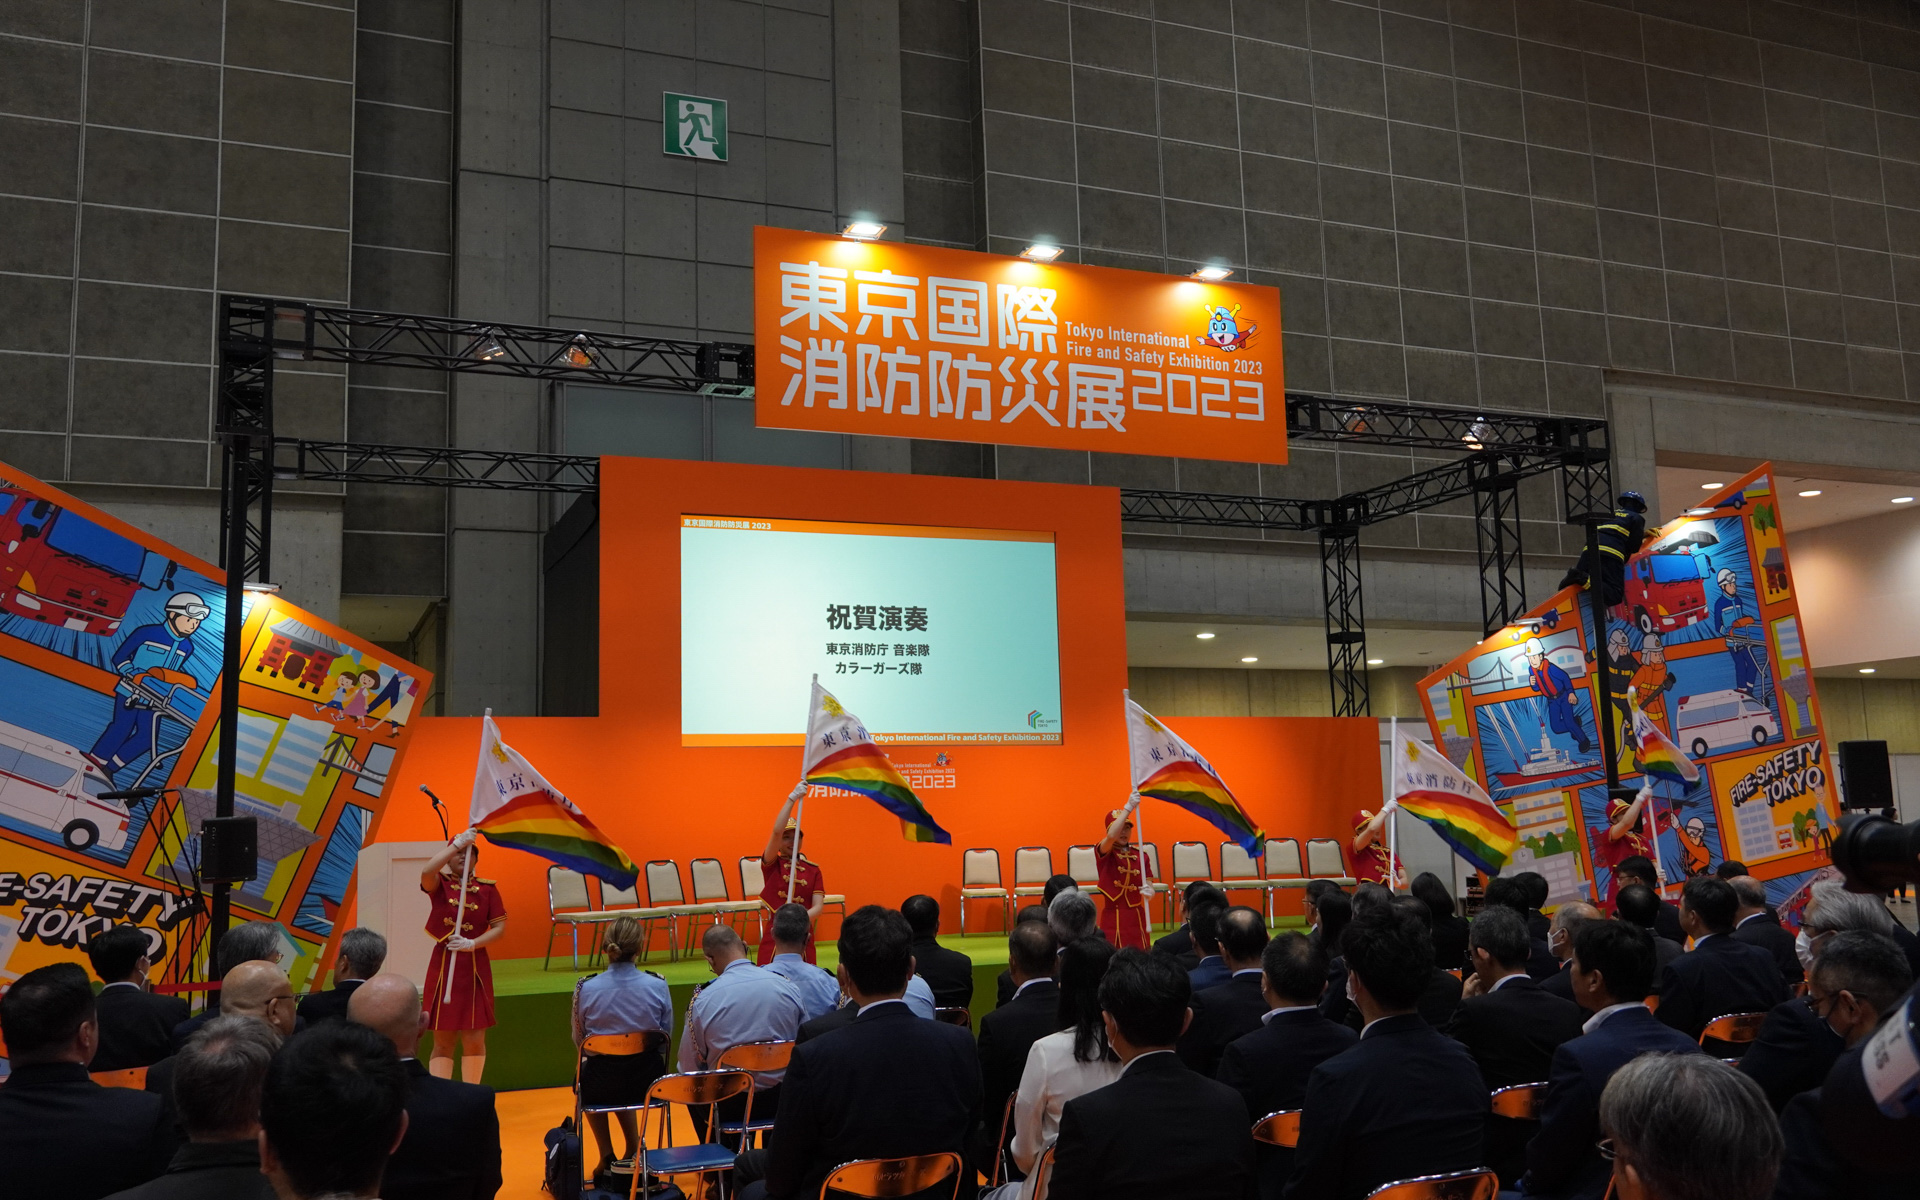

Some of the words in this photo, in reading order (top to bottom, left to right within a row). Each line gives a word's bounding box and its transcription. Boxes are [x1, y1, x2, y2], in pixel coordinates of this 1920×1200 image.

[780, 261, 1057, 353] 東京国際
[1065, 321, 1103, 342] Tokyo
[1108, 325, 1190, 349] International
[1067, 340, 1093, 357] Fire
[1097, 343, 1120, 361] and
[1125, 346, 1165, 368] Safety
[1169, 350, 1230, 372] Exhibition
[1234, 358, 1263, 375] 2023
[752, 522, 772, 530] 2023
[827, 603, 929, 632] 祝賀演奏
[826, 642, 889, 657] 東京消防庁
[893, 642, 930, 657] 音楽隊
[835, 661, 923, 676] カラーガーズ隊
[871, 734, 894, 743] Tokyo
[896, 734, 946, 742] International
[947, 734, 961, 742] Fire
[963, 734, 976, 742] and
[978, 734, 1002, 743] Safety
[1003, 734, 1040, 742] Exhibition
[1042, 734, 1060, 742] 2023
[1730, 740, 1820, 806] FIRE-SAFETY
[1763, 766, 1822, 805] TOKYO
